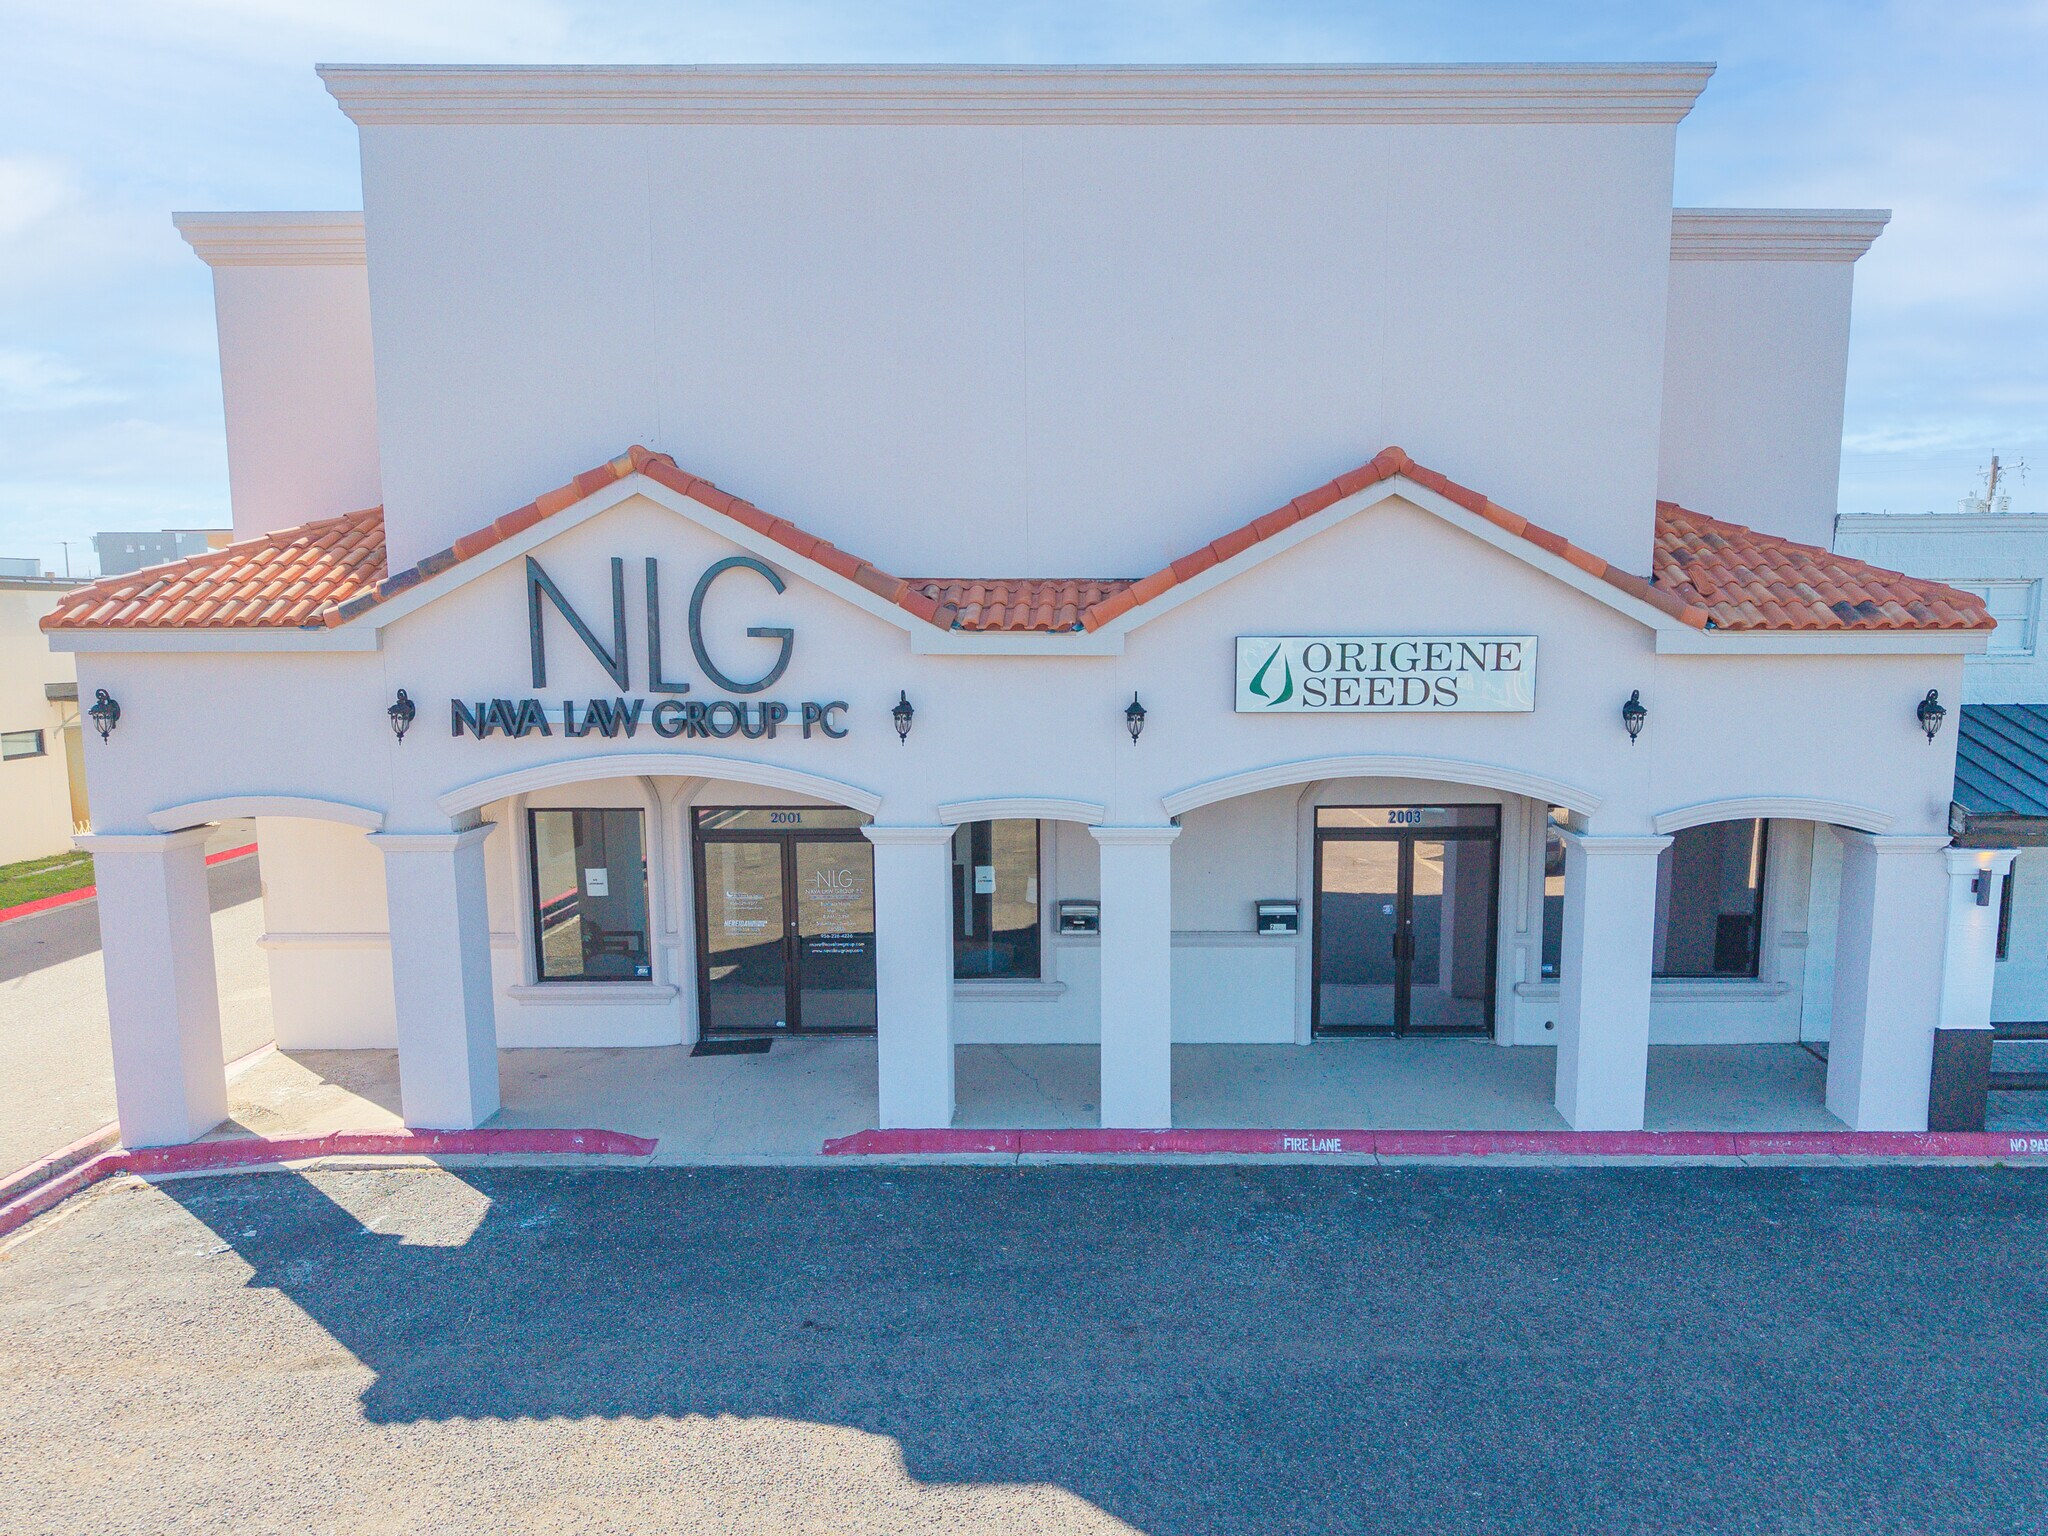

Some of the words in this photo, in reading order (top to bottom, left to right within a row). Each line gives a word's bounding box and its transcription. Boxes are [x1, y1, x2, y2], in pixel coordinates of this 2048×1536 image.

[526, 555, 794, 694] NLG
[1302, 642, 1522, 673] ORIGENE
[1302, 676, 1459, 708] SEEDS
[451, 698, 553, 740] NAVA
[563, 697, 644, 739] LAW
[651, 699, 789, 739] GROUP
[801, 700, 850, 739] PC
[770, 812, 802, 824] 2001
[1388, 810, 1421, 824] 2003
[817, 869, 853, 888] NLG
[1284, 1137, 1309, 1151] FIRE
[1312, 1138, 1342, 1152] LANE
[2010, 1138, 2027, 1152] NO
